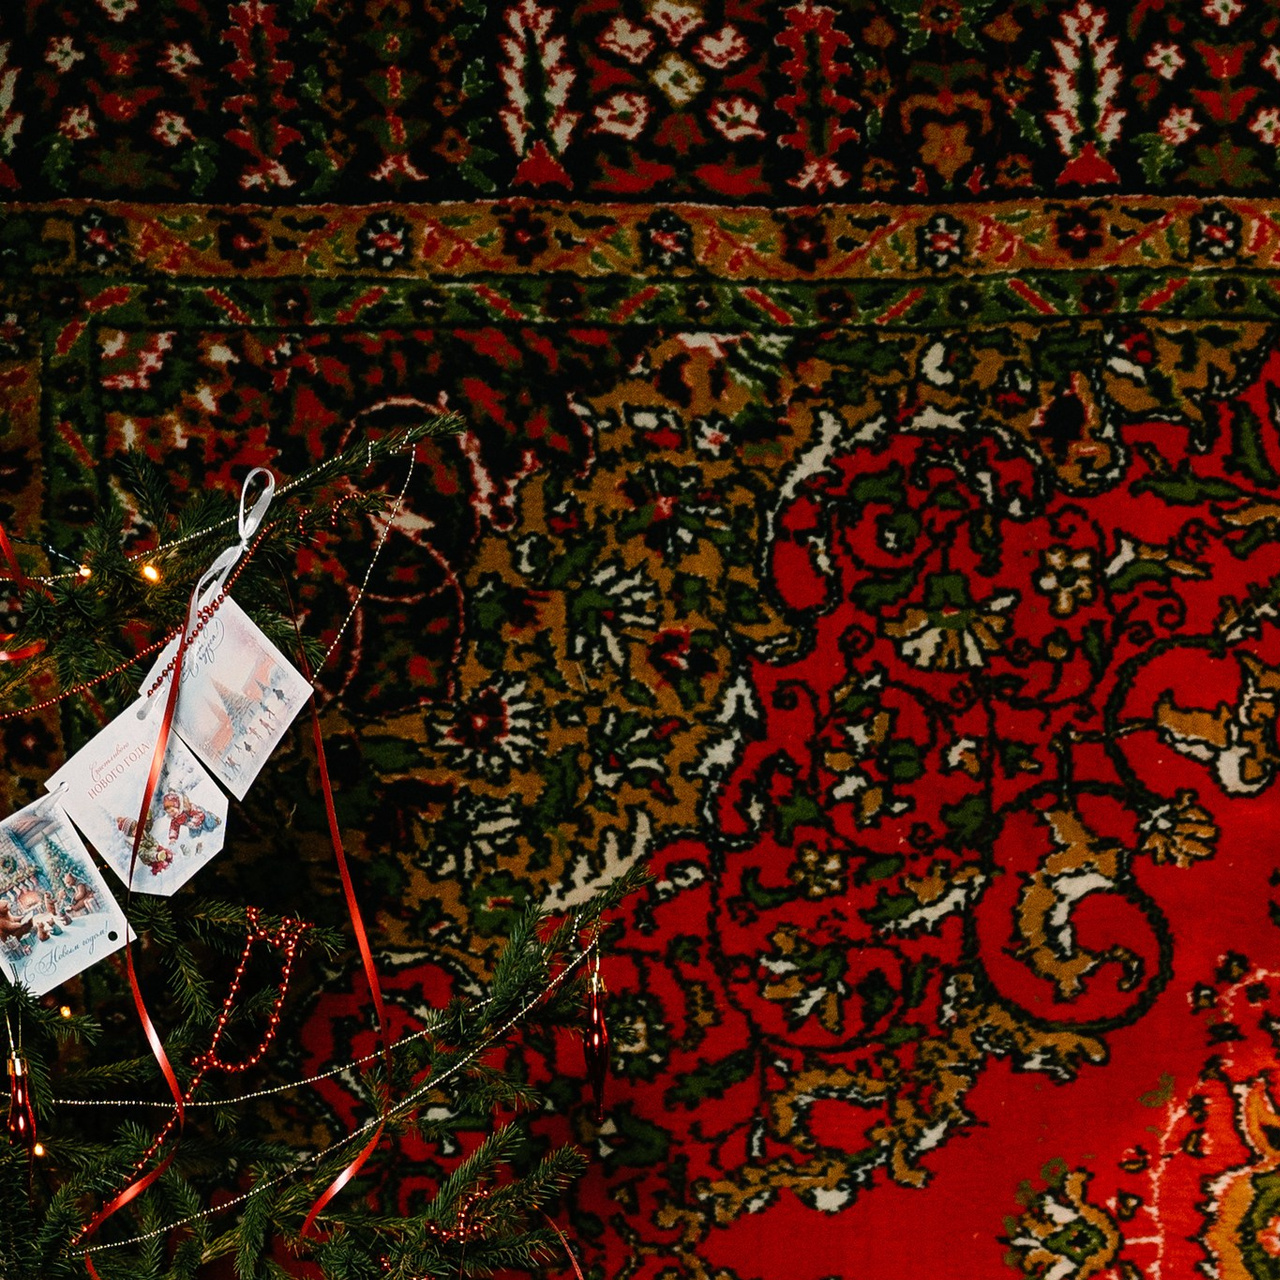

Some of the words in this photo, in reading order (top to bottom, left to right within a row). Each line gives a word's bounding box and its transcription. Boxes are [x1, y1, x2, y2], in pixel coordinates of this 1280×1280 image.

[88, 764, 125, 800] НОВОГО
[123, 743, 150, 768] ГОДА
[23, 958, 36, 984] С
[35, 945, 79, 977] Новым
[82, 920, 108, 955] годом!
